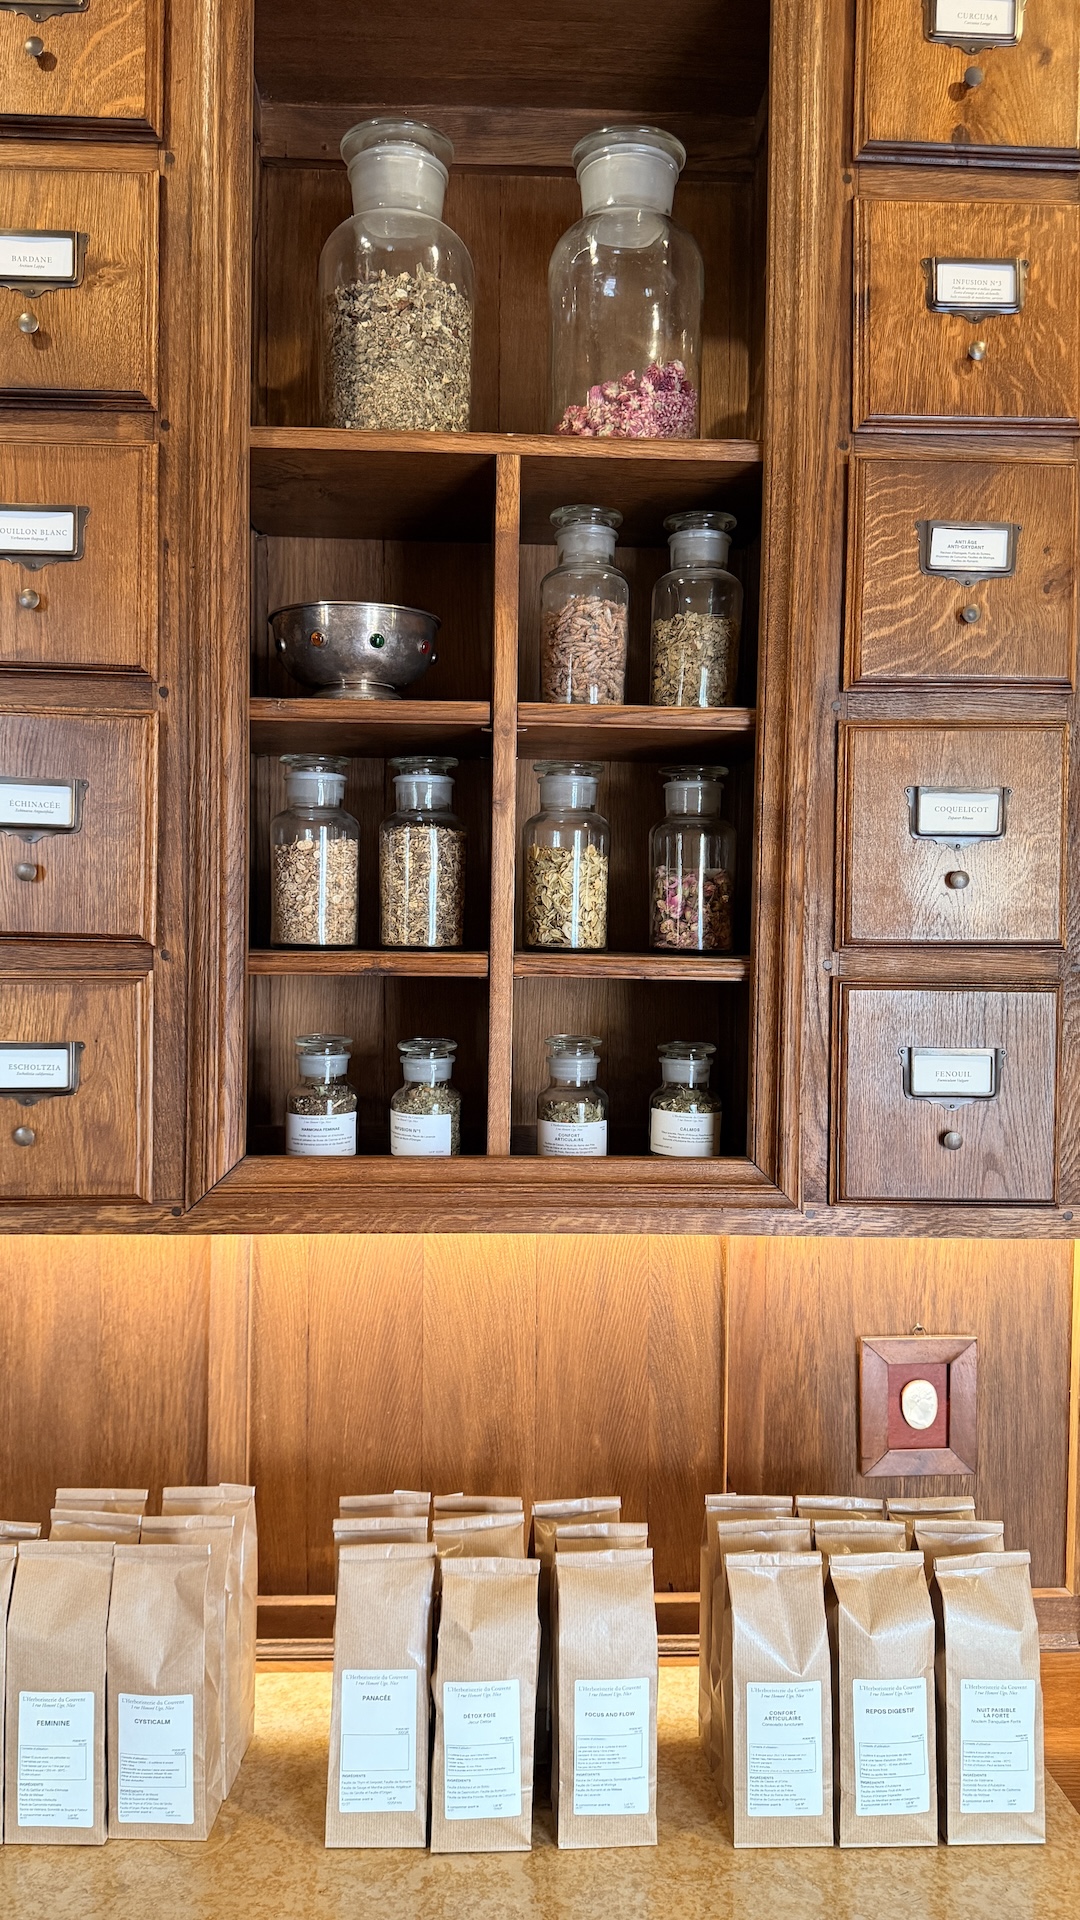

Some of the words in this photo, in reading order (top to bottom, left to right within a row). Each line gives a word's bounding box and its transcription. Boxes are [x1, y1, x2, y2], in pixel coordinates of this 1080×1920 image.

[957, 12, 998, 21] CURCUMA
[9, 799, 61, 808] ÉCHINACÉE
[934, 806, 989, 814] COQUELICOT
